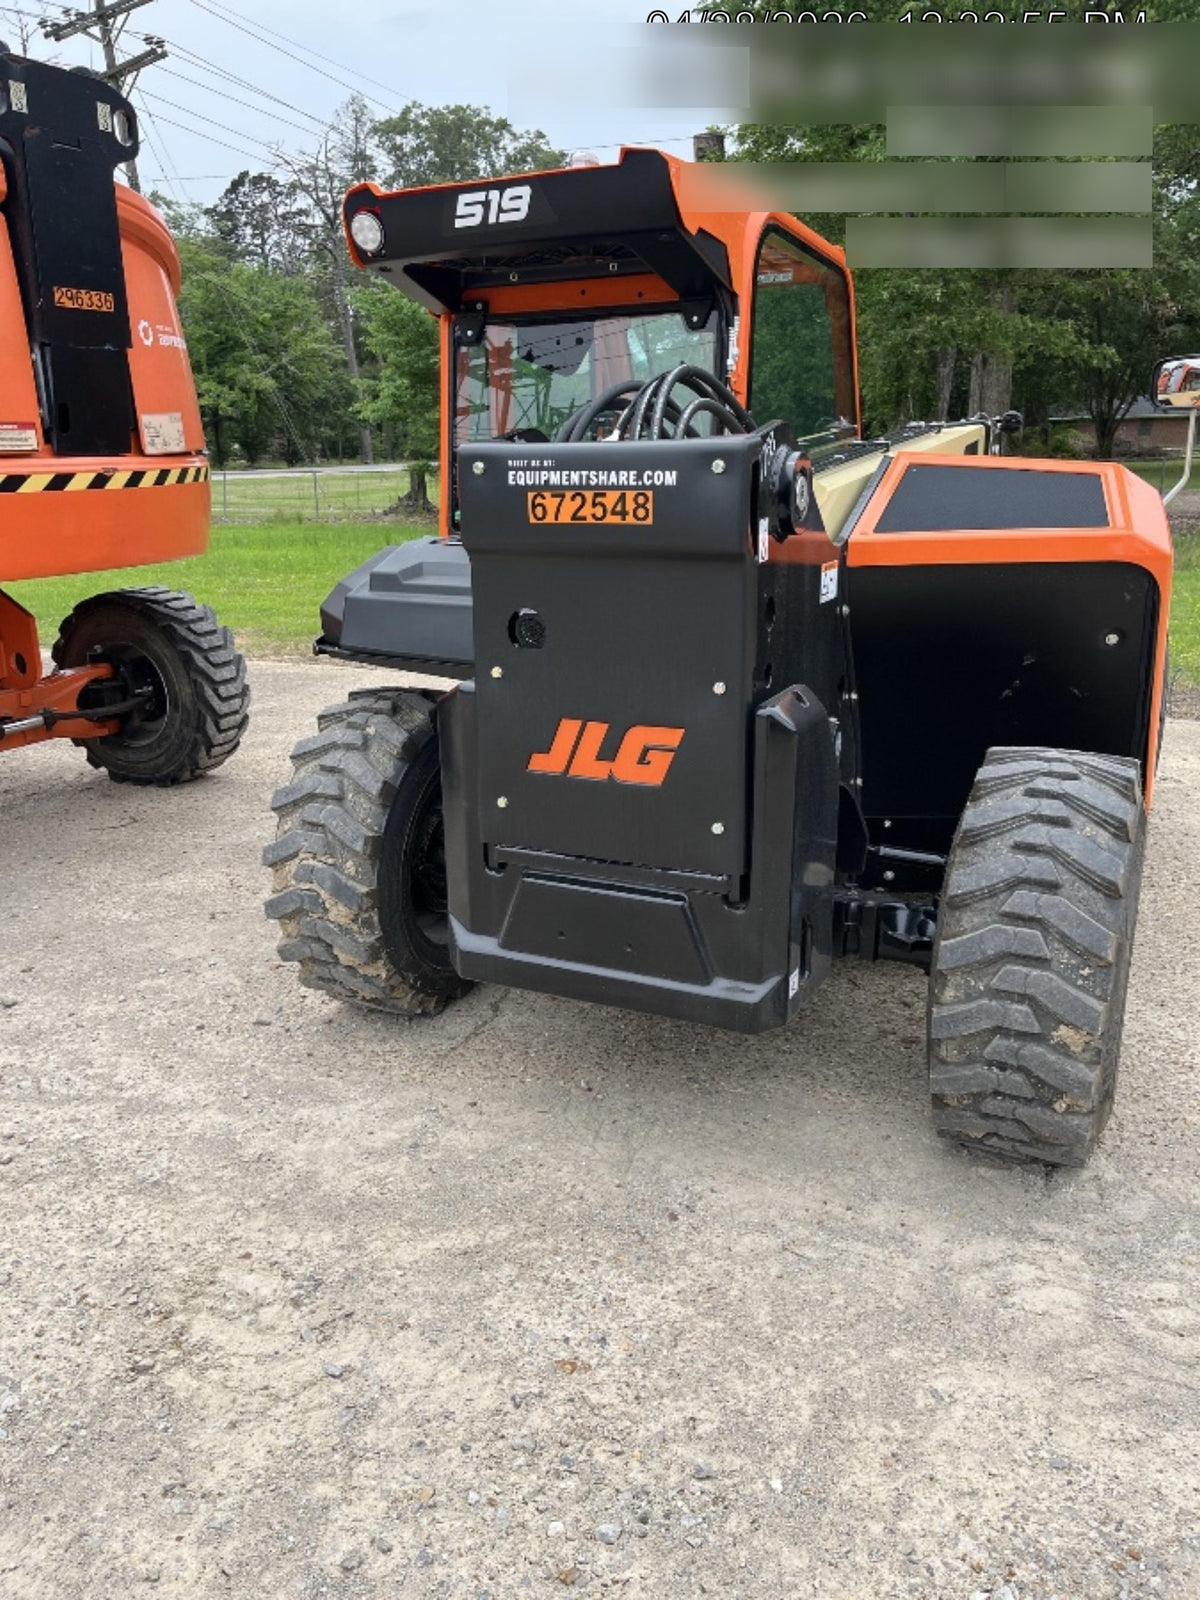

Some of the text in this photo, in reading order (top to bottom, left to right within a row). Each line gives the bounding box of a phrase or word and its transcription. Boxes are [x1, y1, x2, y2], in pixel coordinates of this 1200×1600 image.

[454, 185, 532, 228] 519
[56, 287, 112, 310] 296336
[507, 470, 678, 486] EQUIPMENTSHARE.COM
[530, 491, 650, 522] 672548
[526, 718, 685, 787] JLG
